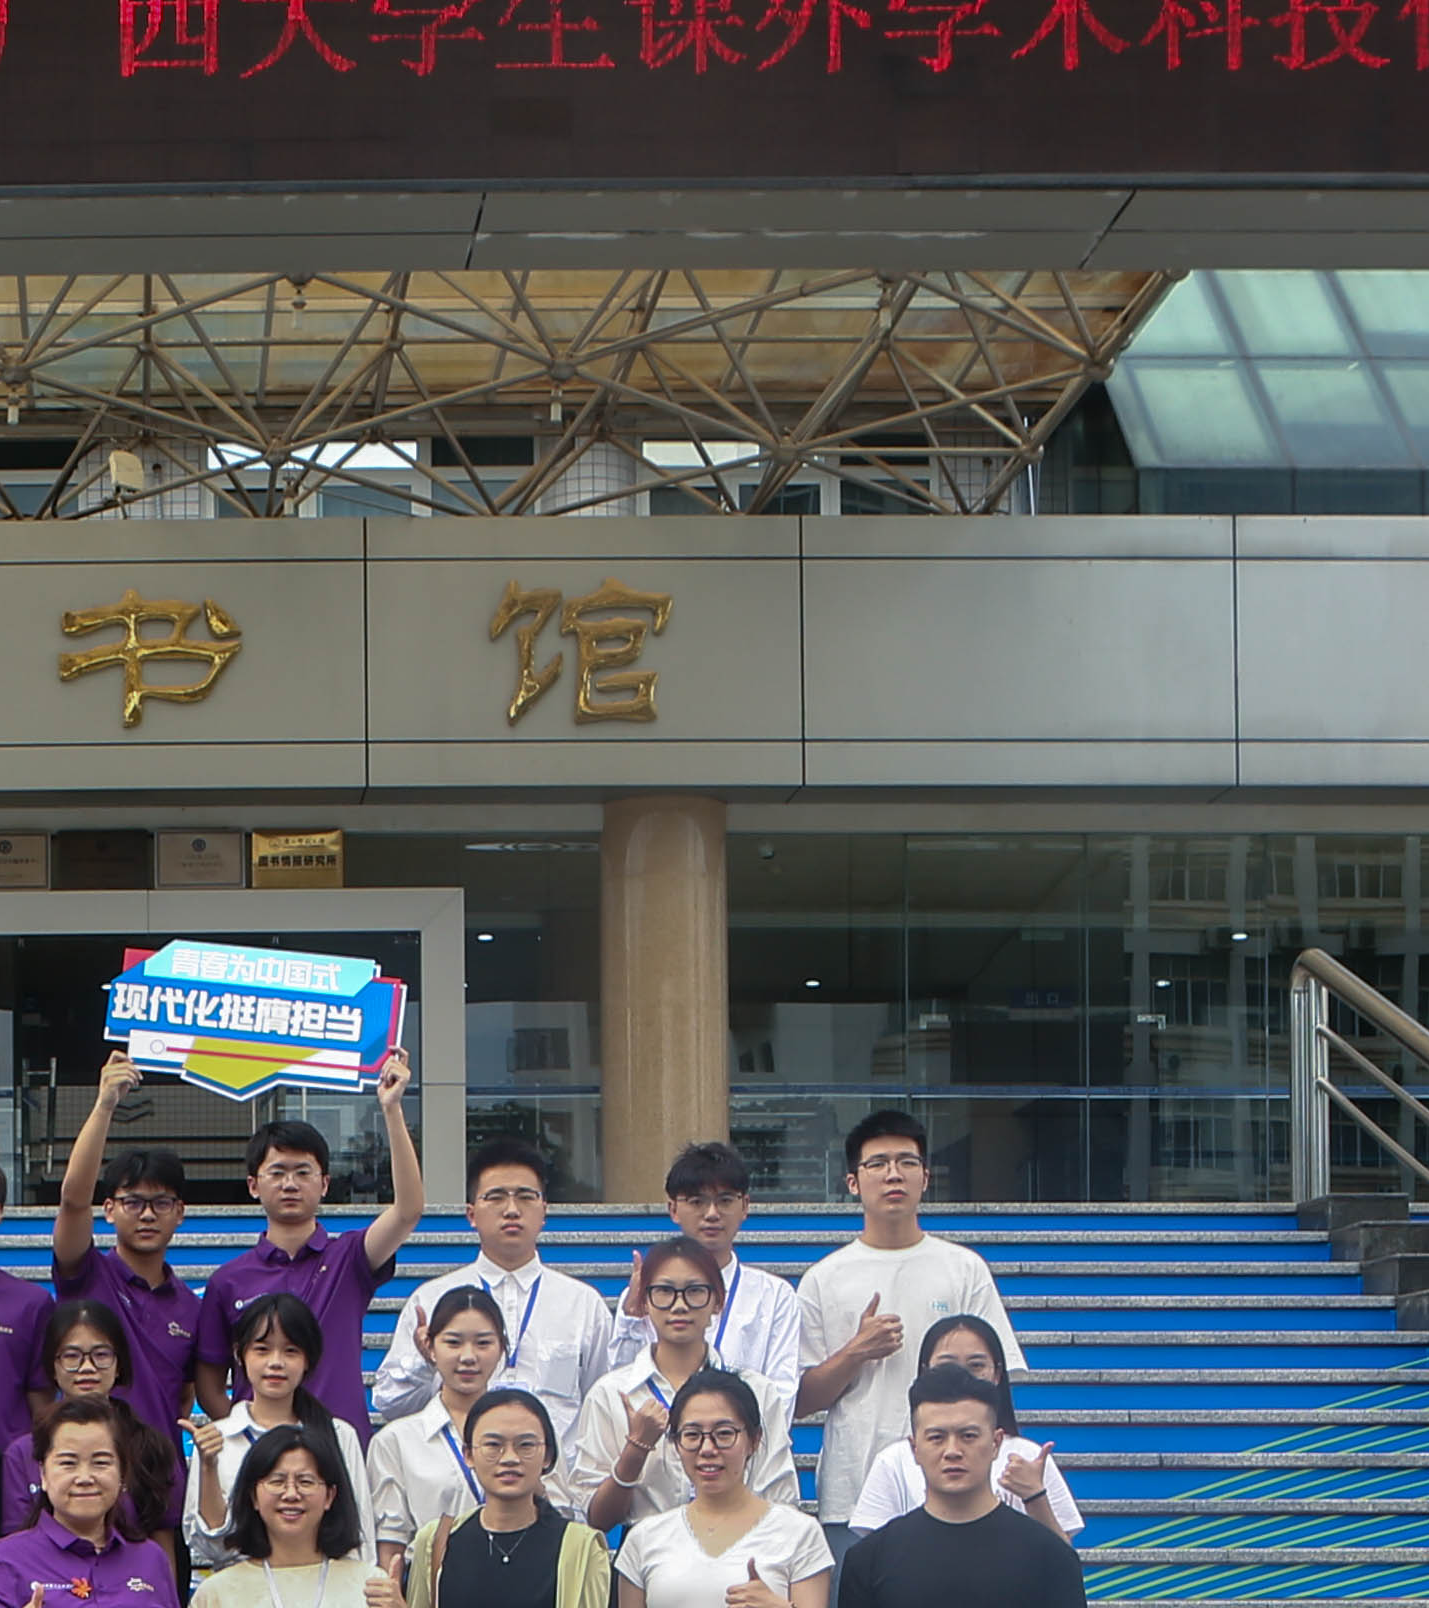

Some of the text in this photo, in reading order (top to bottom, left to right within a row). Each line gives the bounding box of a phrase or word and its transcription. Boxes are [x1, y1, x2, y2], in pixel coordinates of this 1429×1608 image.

[171, 947, 343, 991] 青春为中国式
[110, 982, 363, 1042] 现代化挺膺担当
